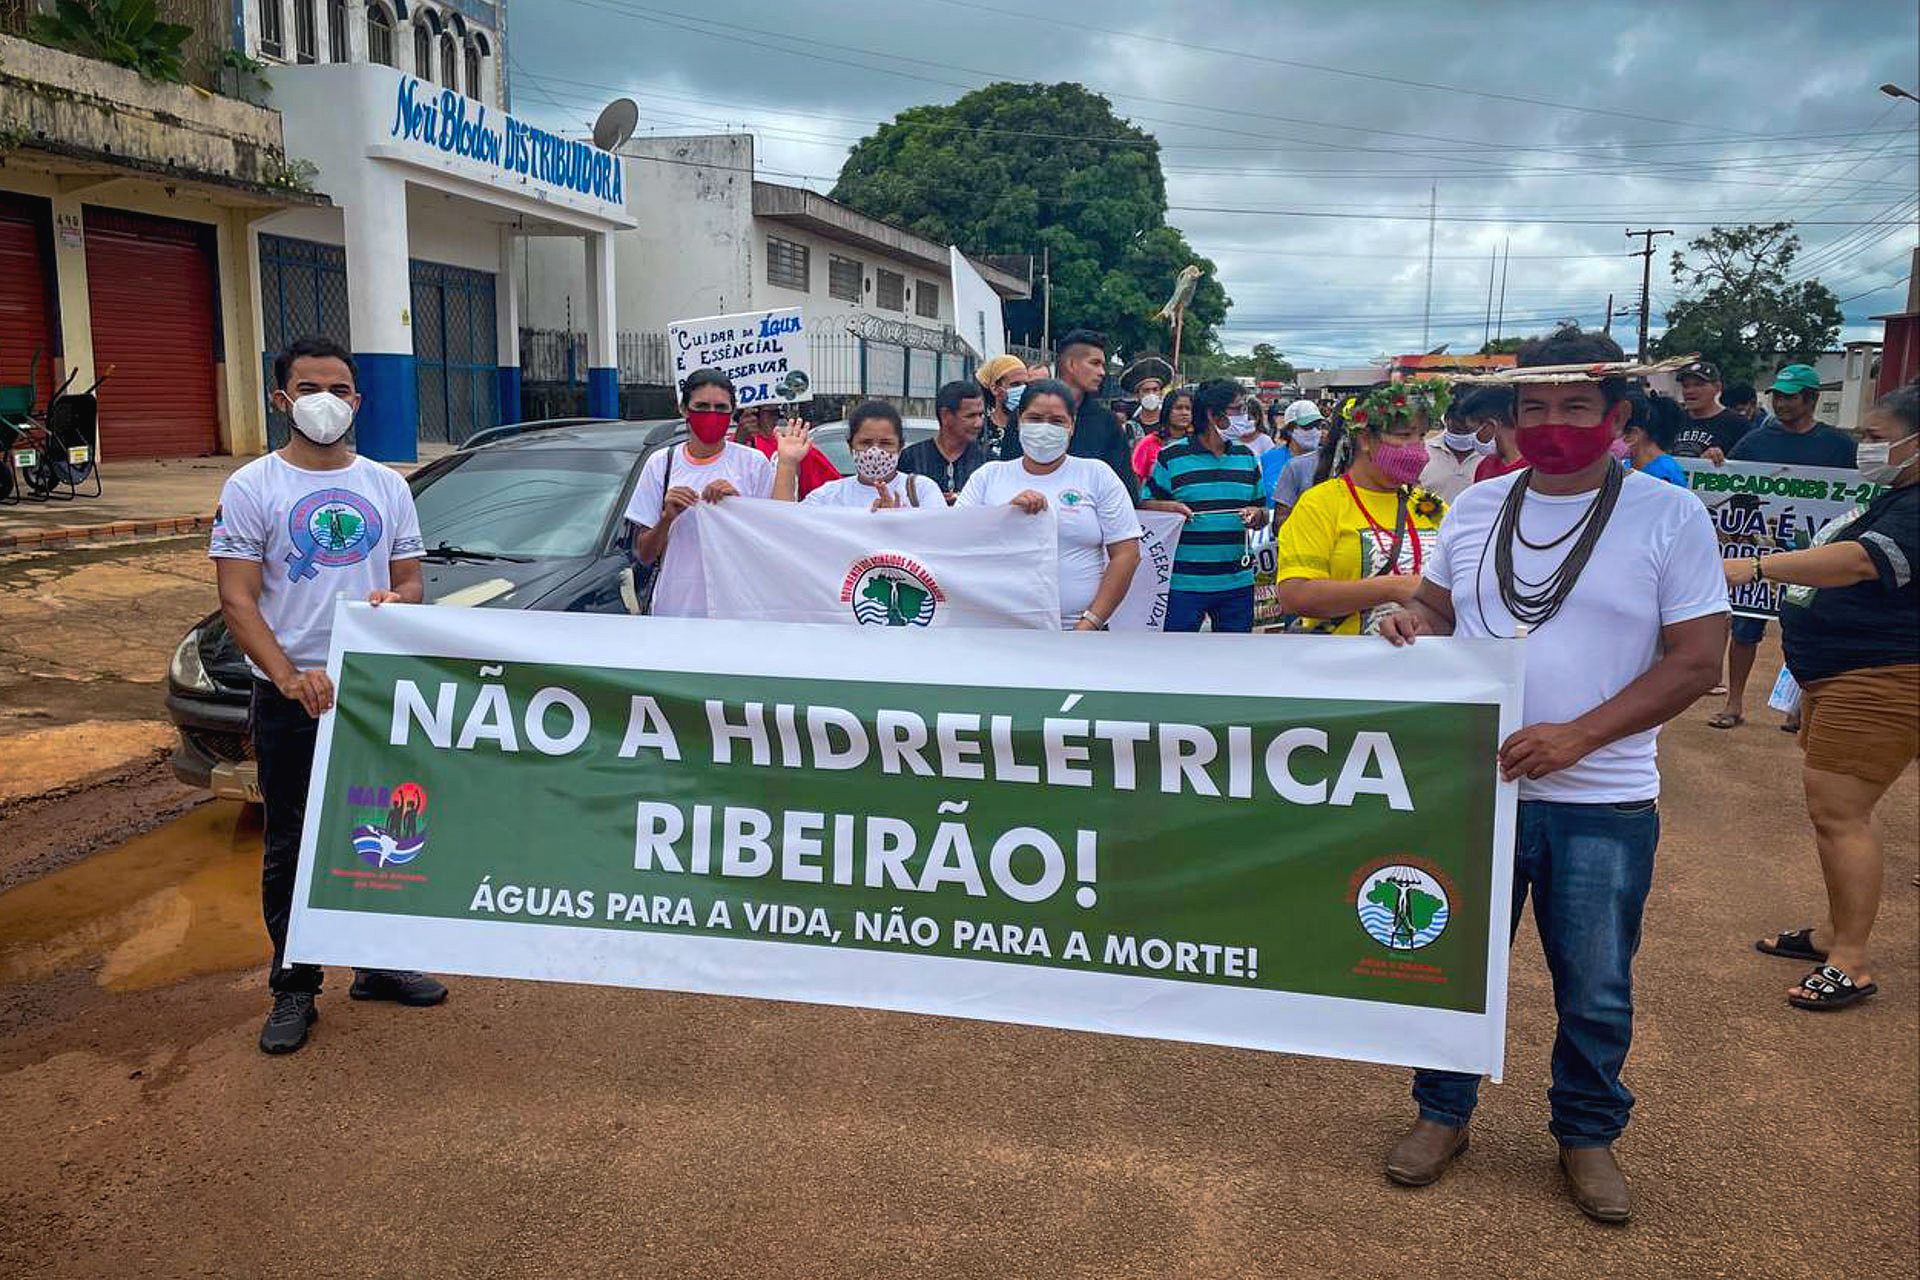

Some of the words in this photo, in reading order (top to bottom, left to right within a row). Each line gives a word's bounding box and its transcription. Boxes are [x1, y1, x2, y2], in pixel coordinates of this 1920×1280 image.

[391, 75, 437, 145] Neri
[759, 313, 801, 338] ÁGUA
[1692, 472, 1828, 500] PESCADORES
[1779, 506, 1796, 538] É
[389, 665, 591, 756] NÃO
[617, 694, 681, 761] A
[705, 692, 1415, 811] HIDRELÉTRICA
[633, 799, 1098, 908] RIBEIRÃO!
[469, 876, 595, 919] ÁGUAS
[606, 892, 697, 927] PARA
[706, 900, 733, 930] A
[742, 901, 842, 944] VIDA,
[854, 906, 940, 947] NÃO
[953, 920, 1052, 958] PARA
[1062, 930, 1092, 962] A
[1103, 934, 1258, 979] MORTE!
